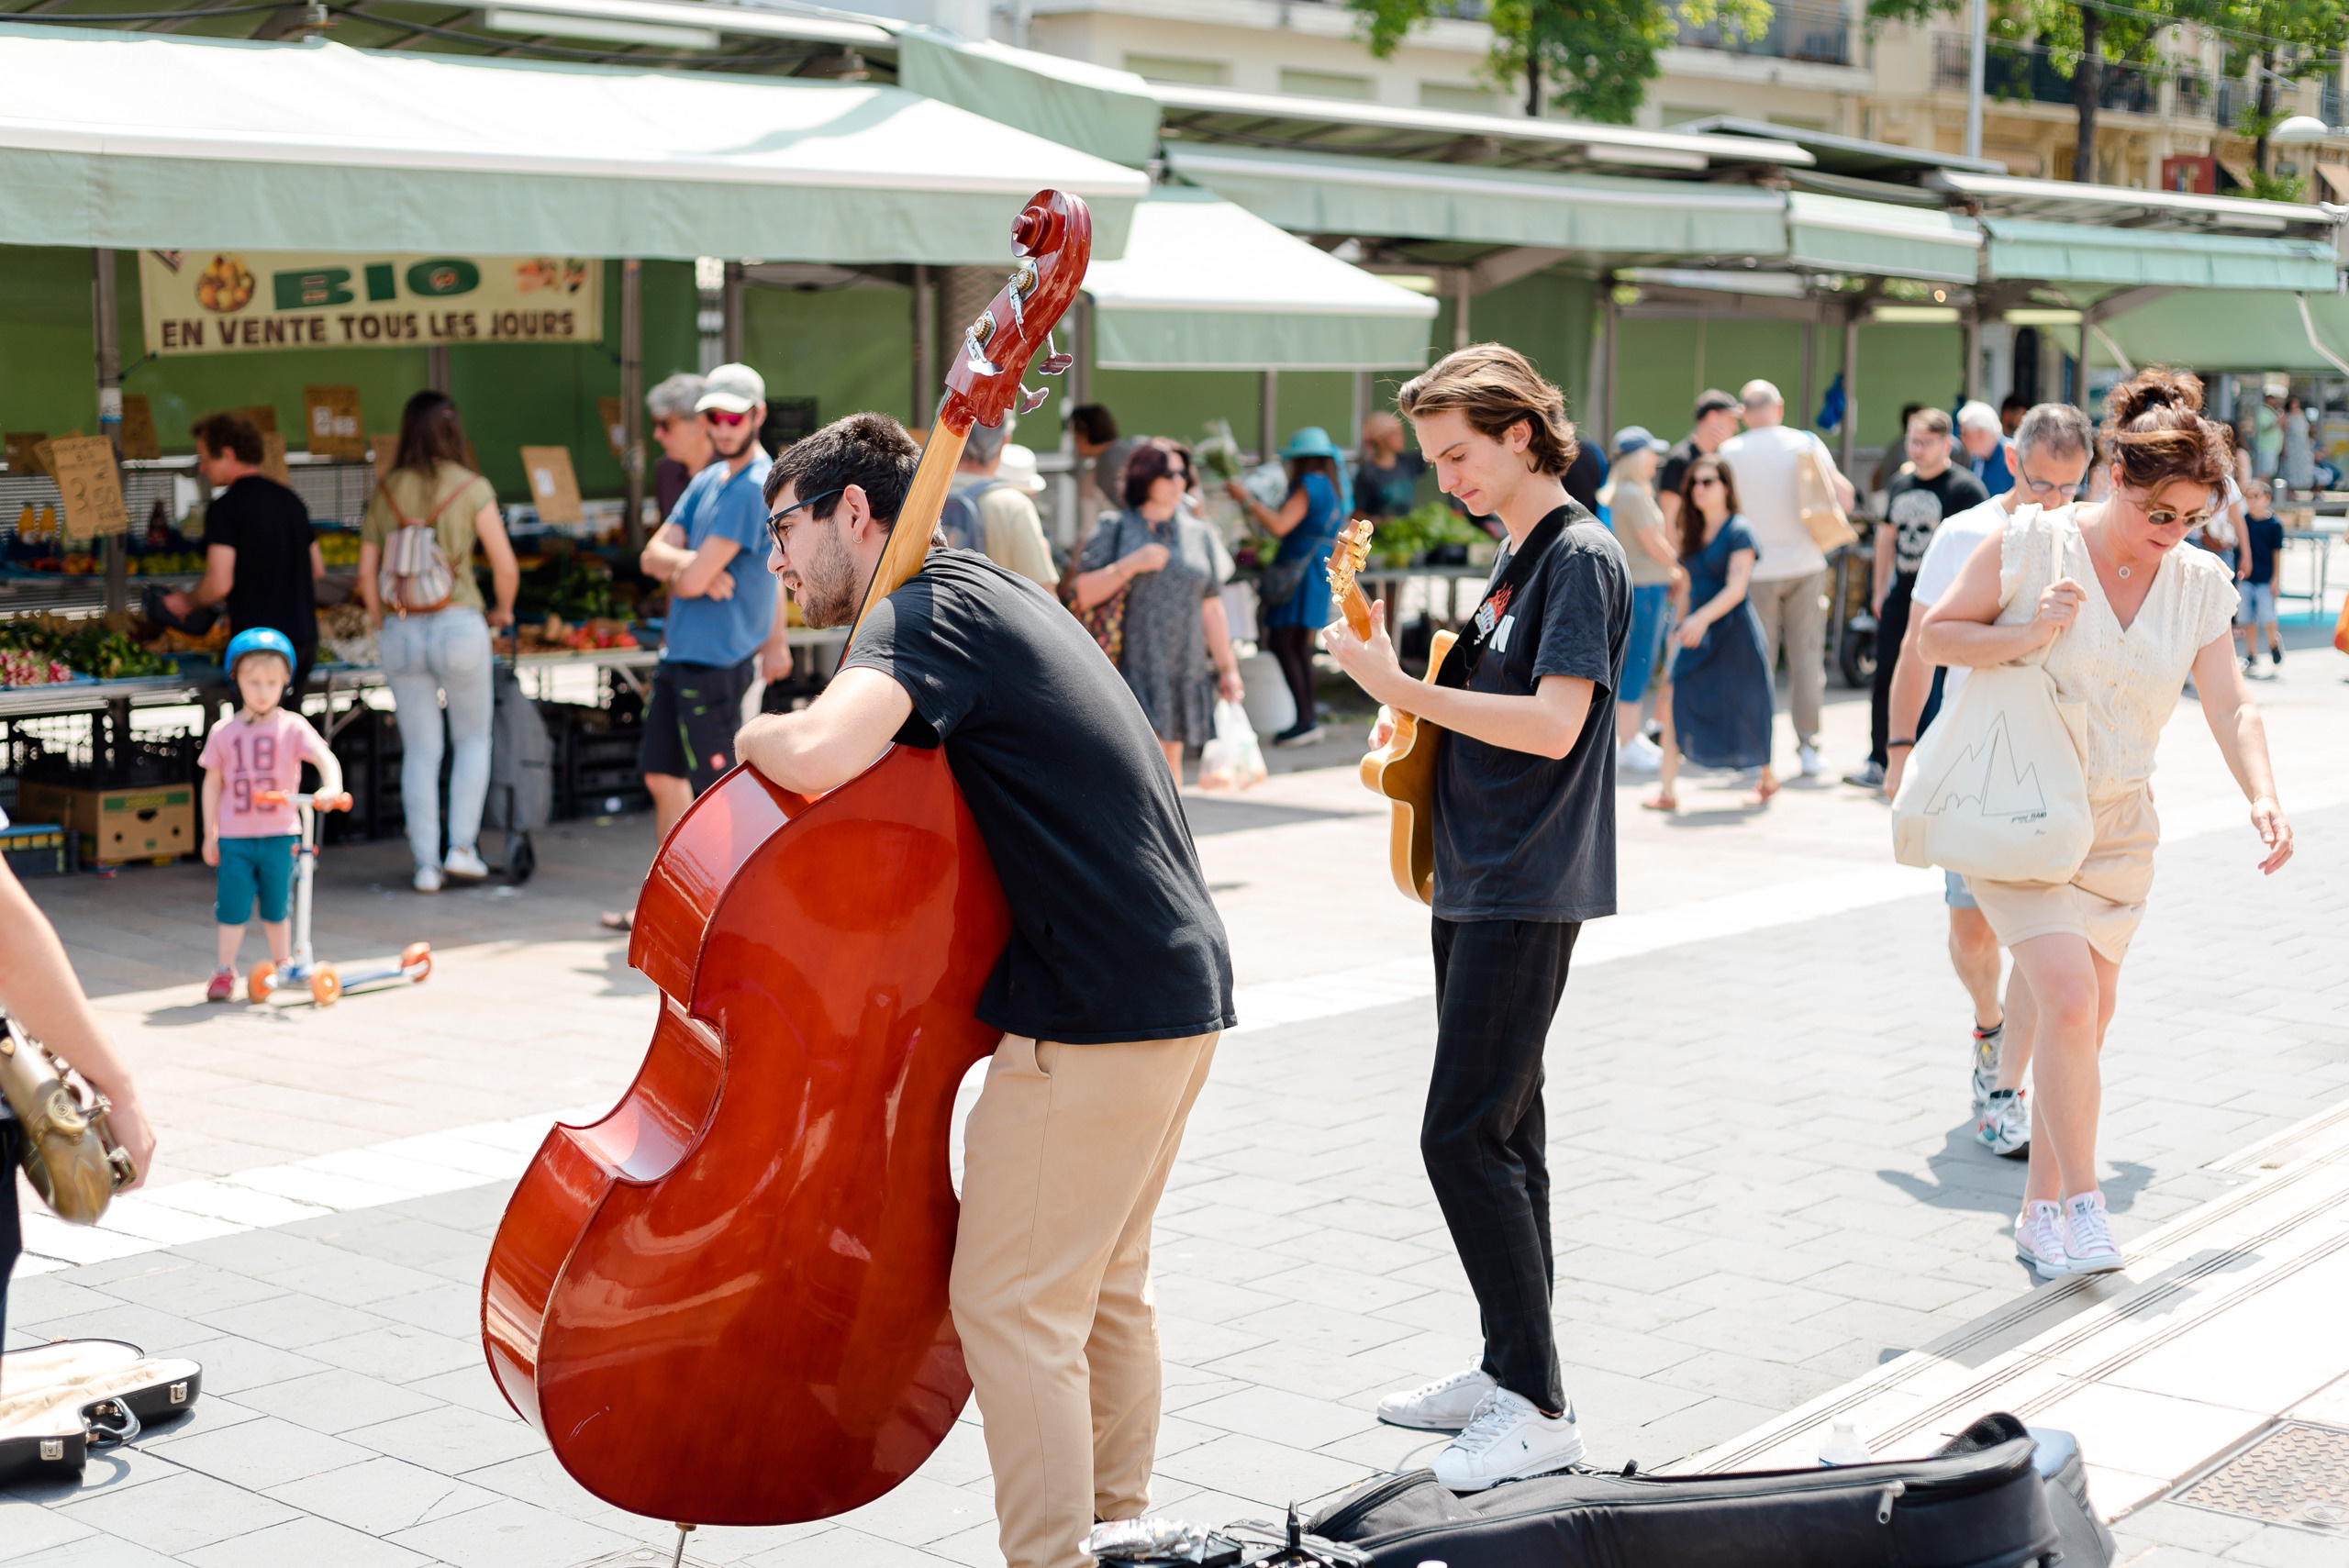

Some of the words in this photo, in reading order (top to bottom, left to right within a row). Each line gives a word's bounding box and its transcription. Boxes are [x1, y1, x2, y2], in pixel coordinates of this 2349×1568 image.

[273, 260, 480, 310] BIO
[162, 320, 203, 347] EN
[218, 317, 327, 345] VENTE
[339, 313, 418, 340] TOUS
[429, 312, 476, 338] LES
[491, 310, 574, 337] JOURS
[70, 476, 90, 513] 3
[234, 737, 275, 773] 18
